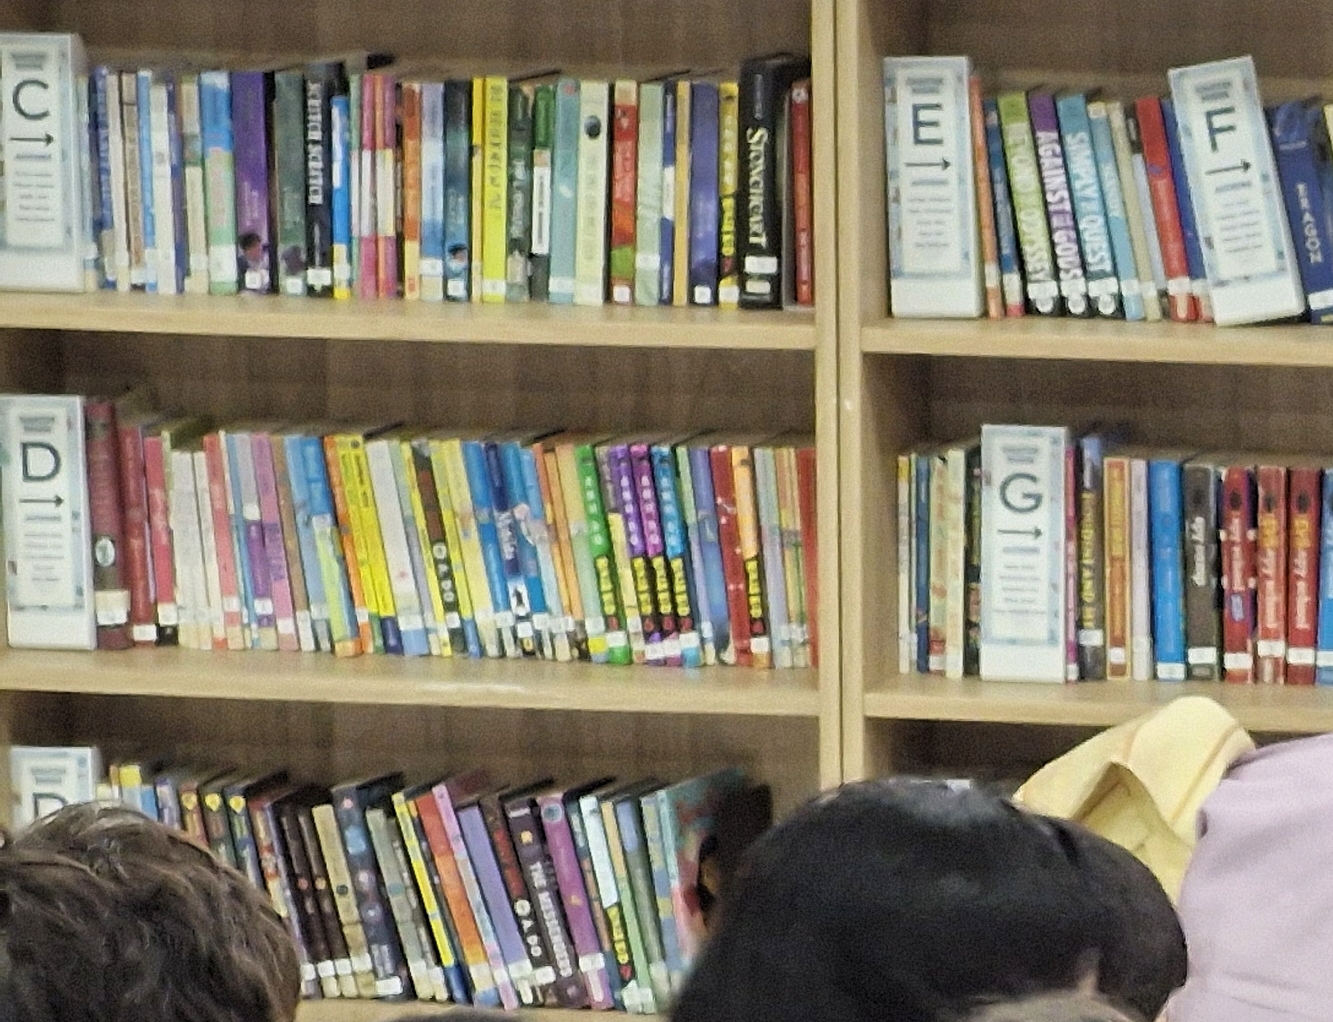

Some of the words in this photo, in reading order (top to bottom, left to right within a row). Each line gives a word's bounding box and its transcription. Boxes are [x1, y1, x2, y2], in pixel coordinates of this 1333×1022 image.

[12, 79, 51, 121] C
[912, 103, 944, 146] E
[1205, 106, 1237, 153] F
[1036, 131, 1070, 214] AGAINST
[1056, 228, 1086, 280] GODS
[1065, 132, 1099, 198] SIMPLY
[1083, 215, 1114, 272] QUEST
[20, 442, 62, 483] D
[999, 472, 1044, 513] G
